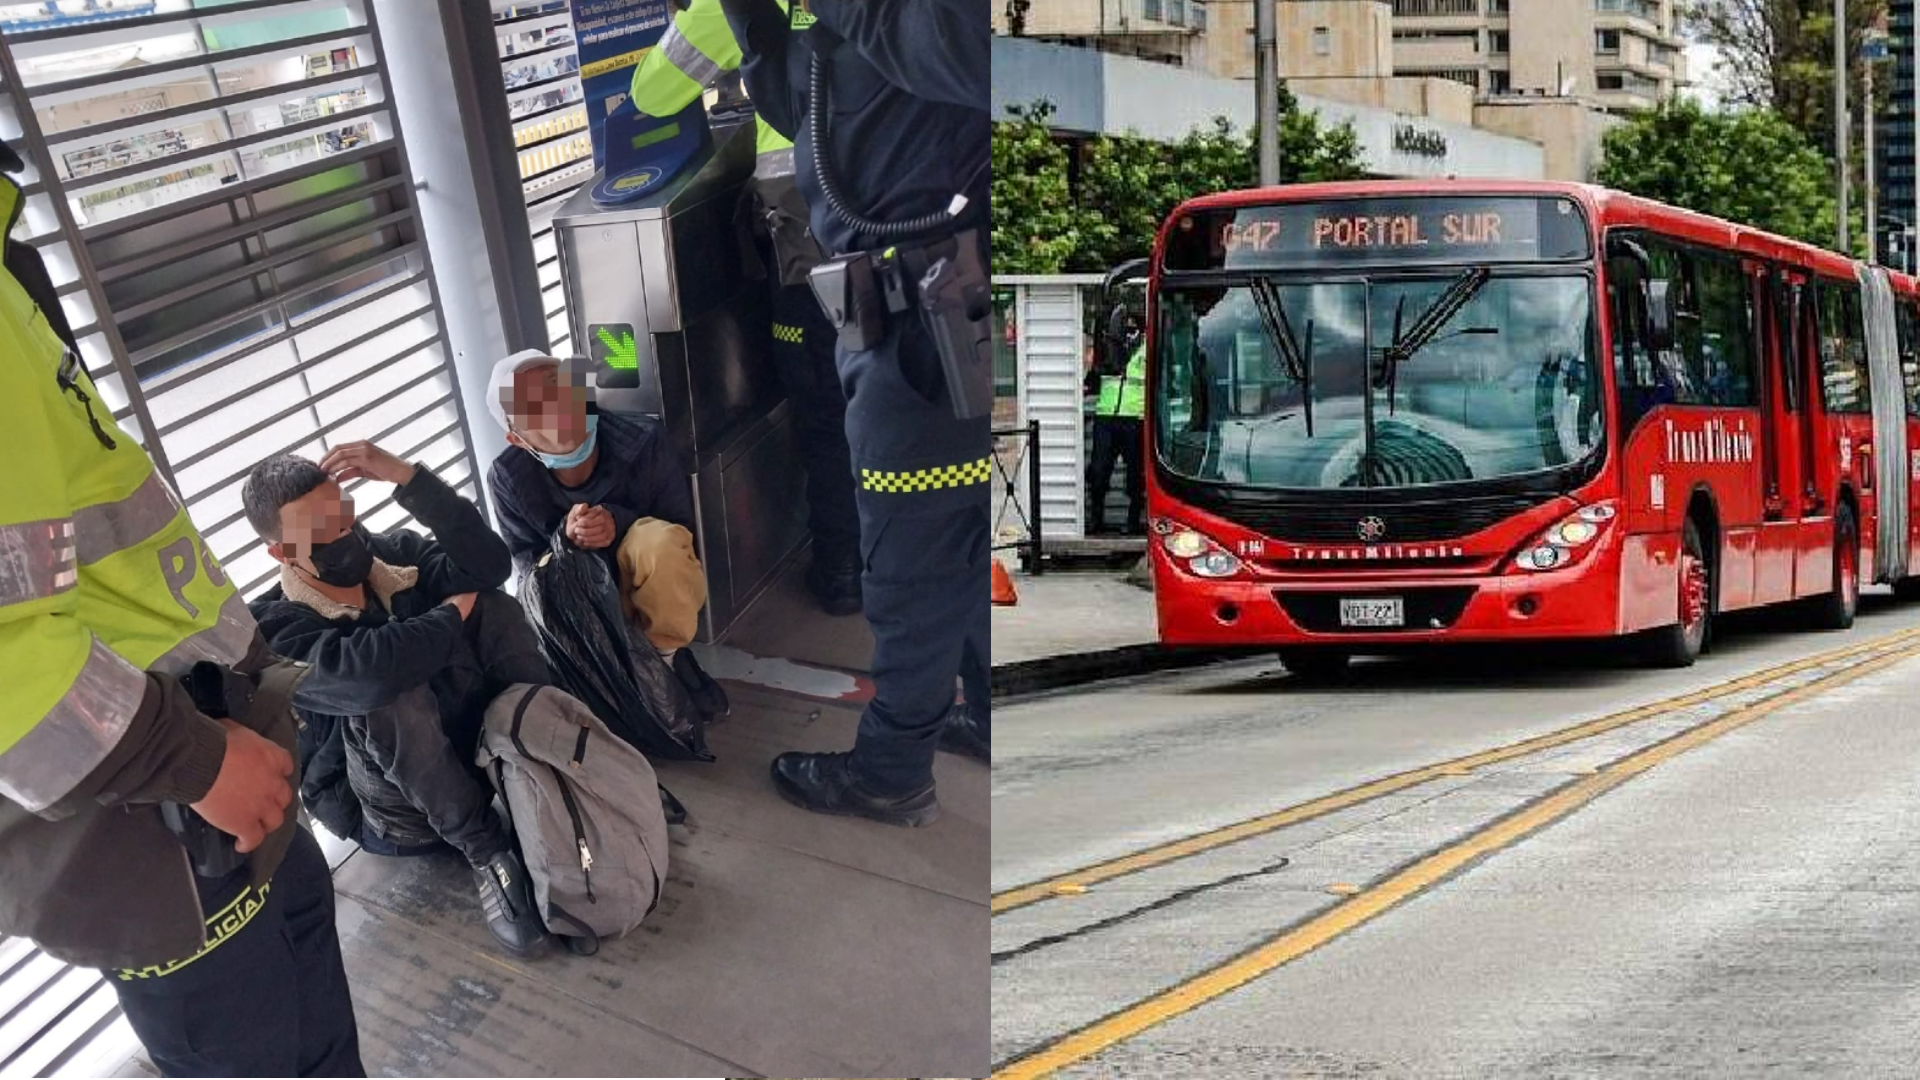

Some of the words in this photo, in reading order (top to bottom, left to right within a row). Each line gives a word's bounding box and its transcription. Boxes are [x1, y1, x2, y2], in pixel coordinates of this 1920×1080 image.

[1222, 221, 1280, 251] G47
[1313, 214, 1429, 250] PORTAL
[1443, 211, 1501, 244] SUR
